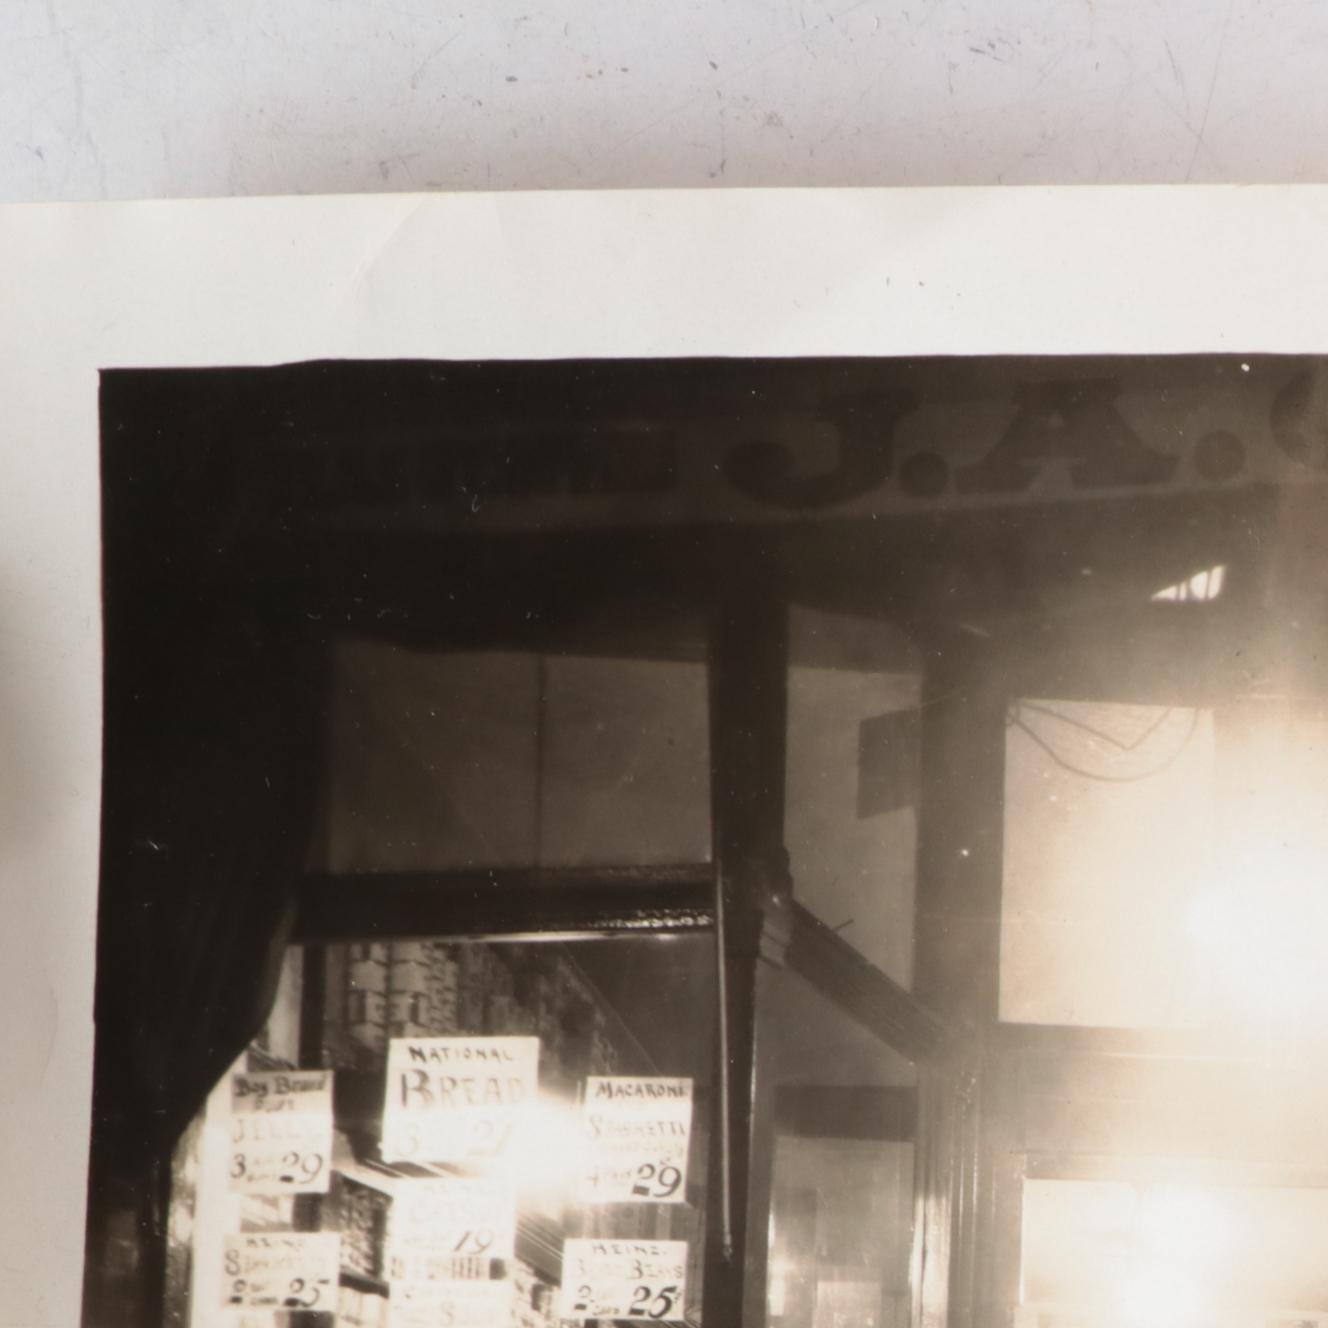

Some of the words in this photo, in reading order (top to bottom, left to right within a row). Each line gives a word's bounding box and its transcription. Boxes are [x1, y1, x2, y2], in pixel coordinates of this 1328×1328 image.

[406, 1045, 515, 1064] NATIONAL
[399, 1067, 526, 1109] BREAD
[594, 1081, 688, 1100] MACARONI
[230, 1152, 247, 1180] 3
[279, 1151, 325, 1185] 29
[453, 1230, 495, 1256] 19
